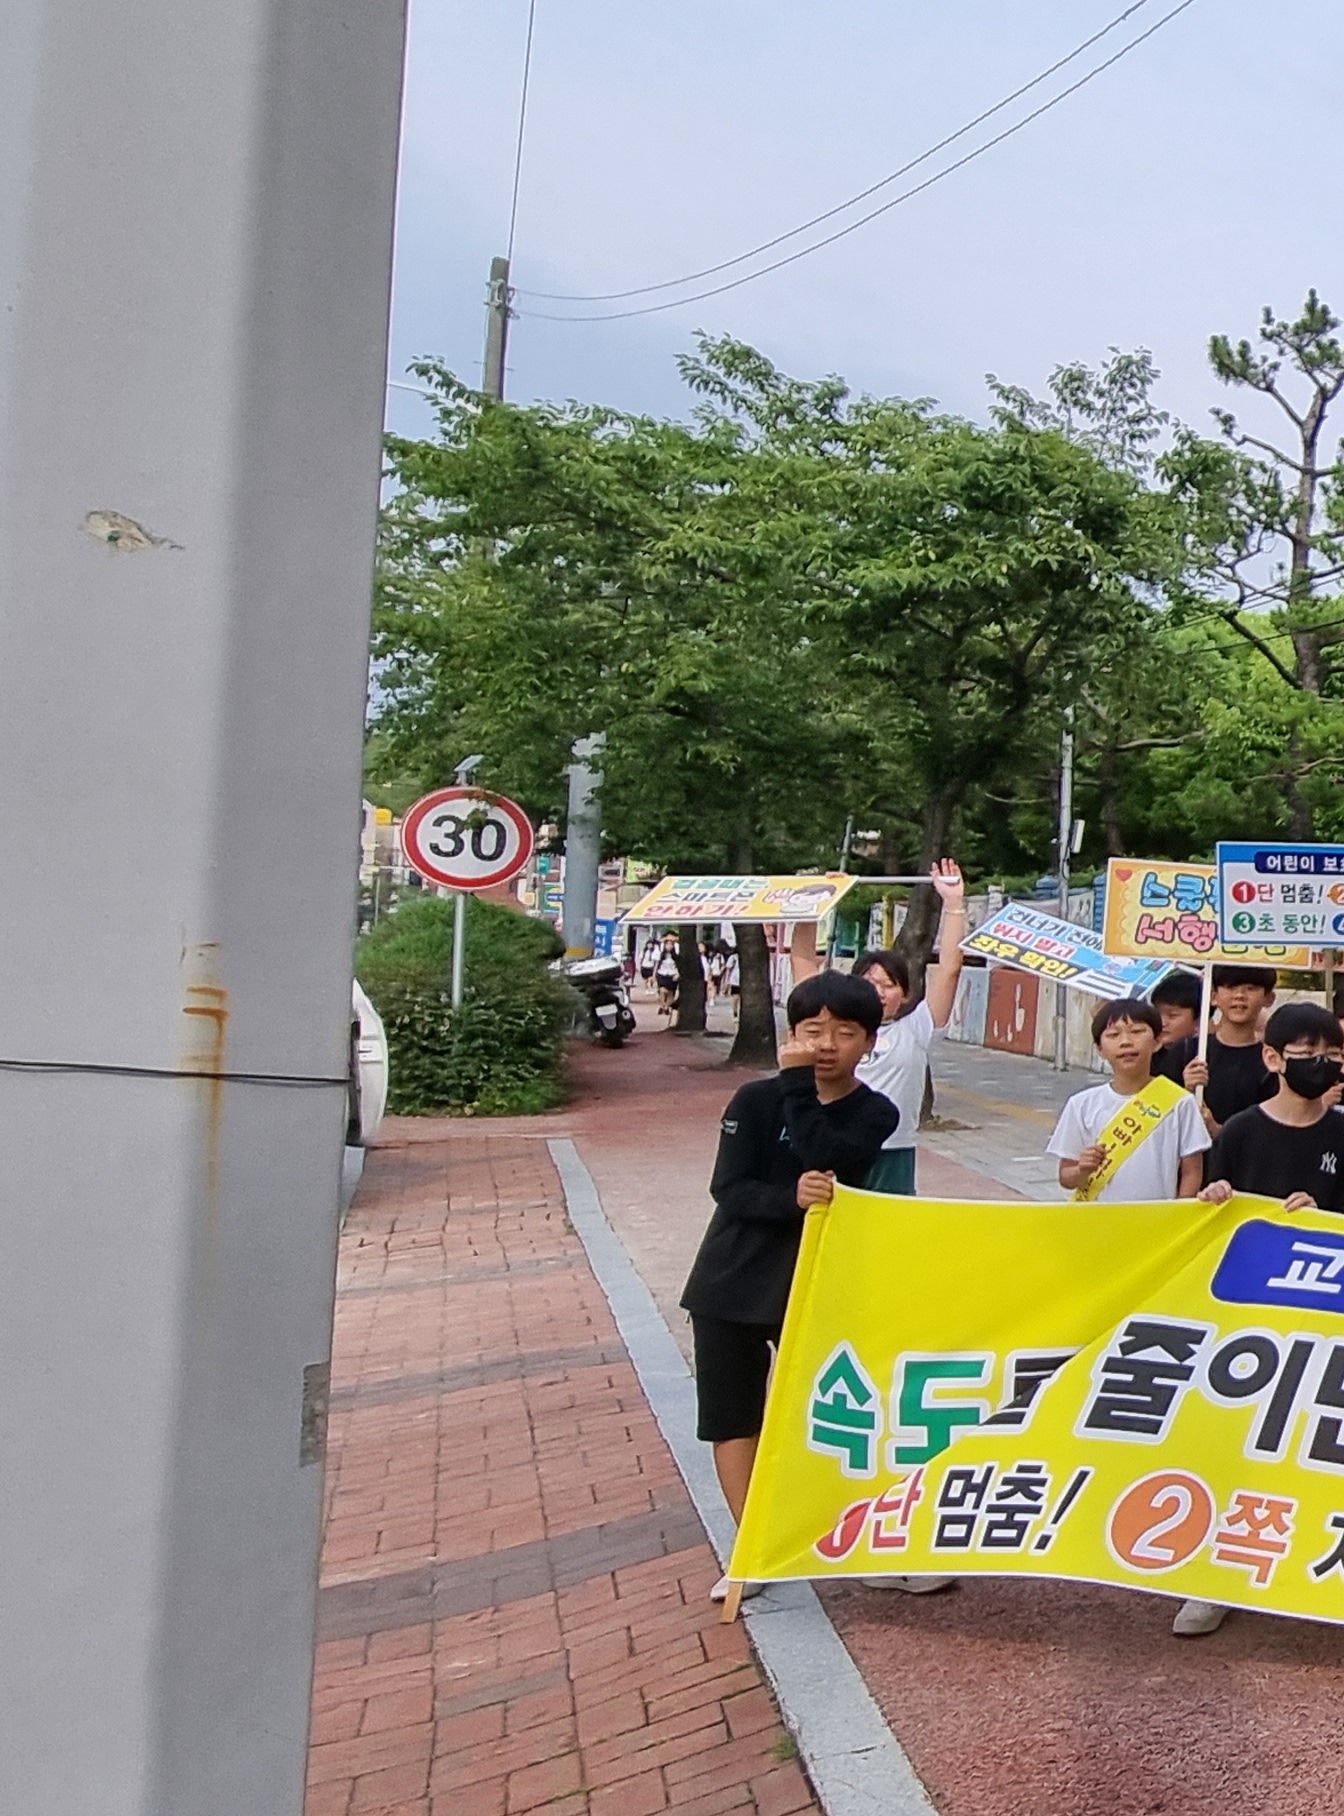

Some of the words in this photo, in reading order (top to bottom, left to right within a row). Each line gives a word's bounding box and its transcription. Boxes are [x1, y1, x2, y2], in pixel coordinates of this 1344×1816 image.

[428, 814, 508, 862] 30
[1266, 854, 1316, 872] 어린이
[655, 891, 755, 903] 스마트폰
[1140, 871, 1218, 914] 스쿨
[1280, 882, 1325, 905] 멈춤!
[1006, 907, 1066, 938] 건너기
[1135, 912, 1218, 953] 서행
[1282, 913, 1326, 935] 동안!
[968, 933, 1020, 959] 좌우
[933, 1463, 1091, 1552] 멈춤!
